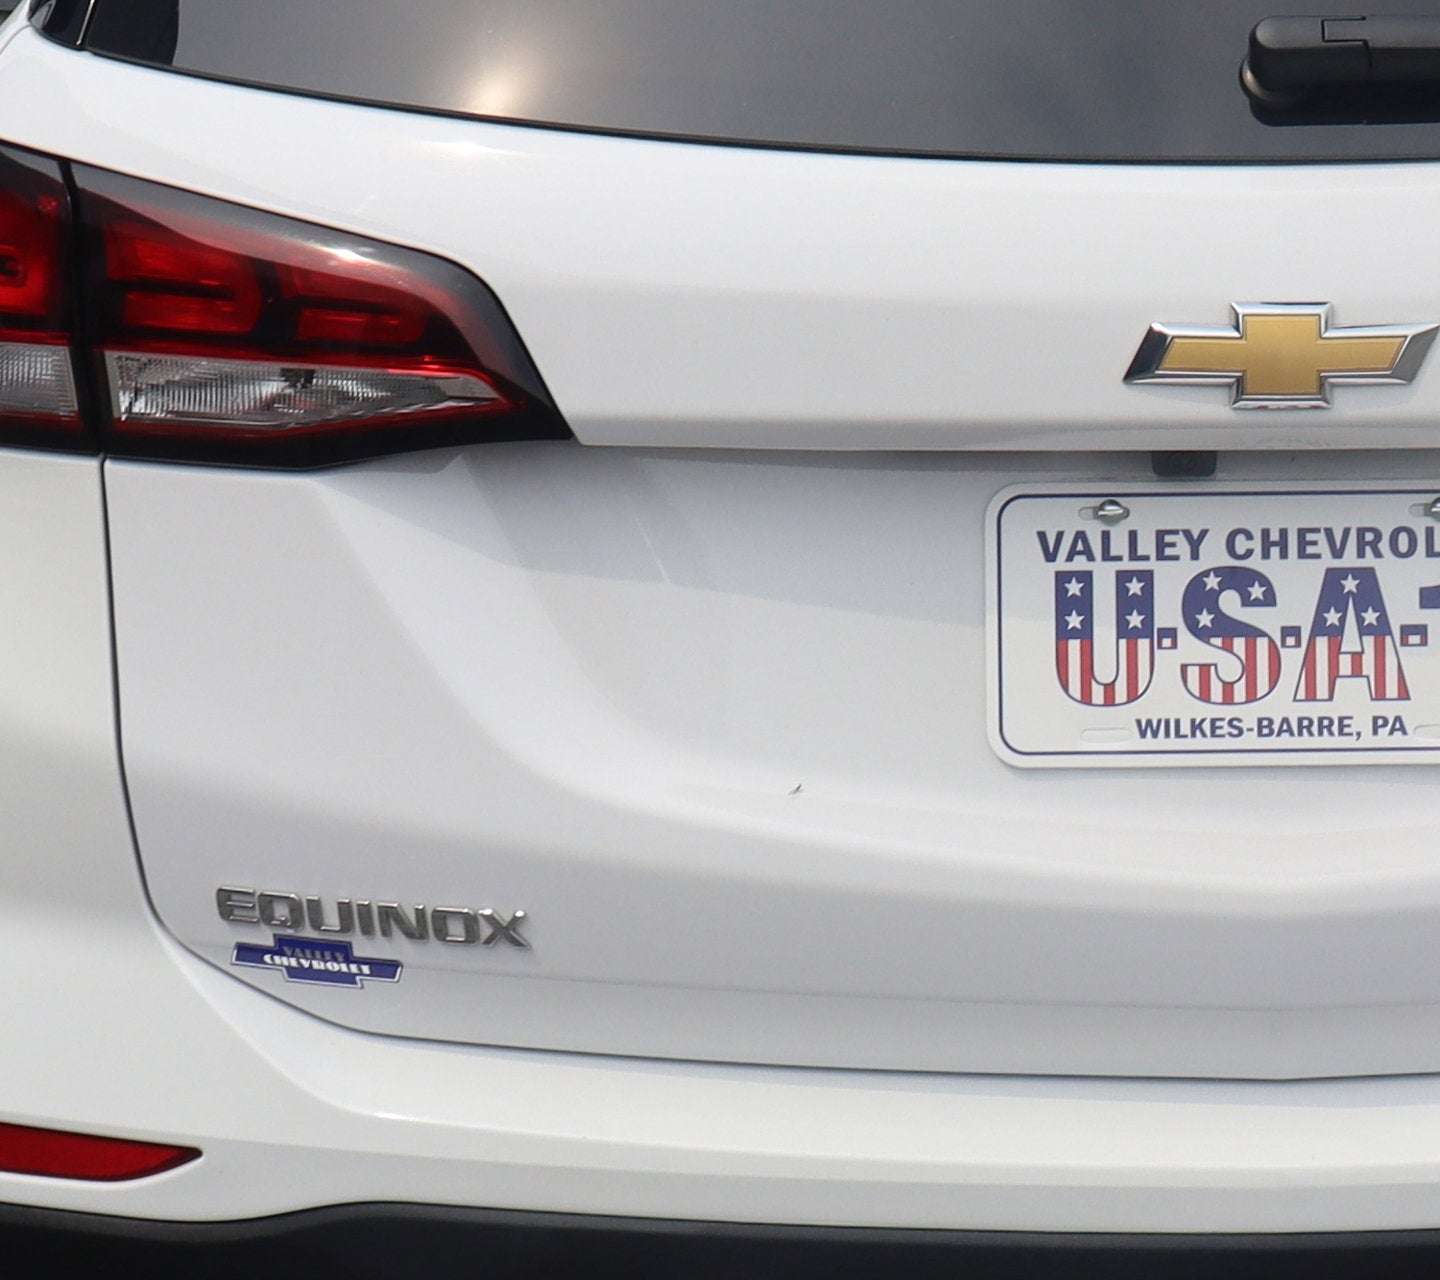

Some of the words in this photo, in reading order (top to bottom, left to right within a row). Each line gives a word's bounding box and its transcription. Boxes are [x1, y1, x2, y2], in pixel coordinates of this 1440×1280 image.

[1036, 528, 1210, 563] VALLEY
[1135, 717, 1362, 742] WILKES-BARRE,
[1372, 716, 1408, 737] PA
[215, 885, 533, 950] EQUINOX
[263, 953, 372, 975] CHEVROLET
[282, 945, 345, 963] VALLEY
